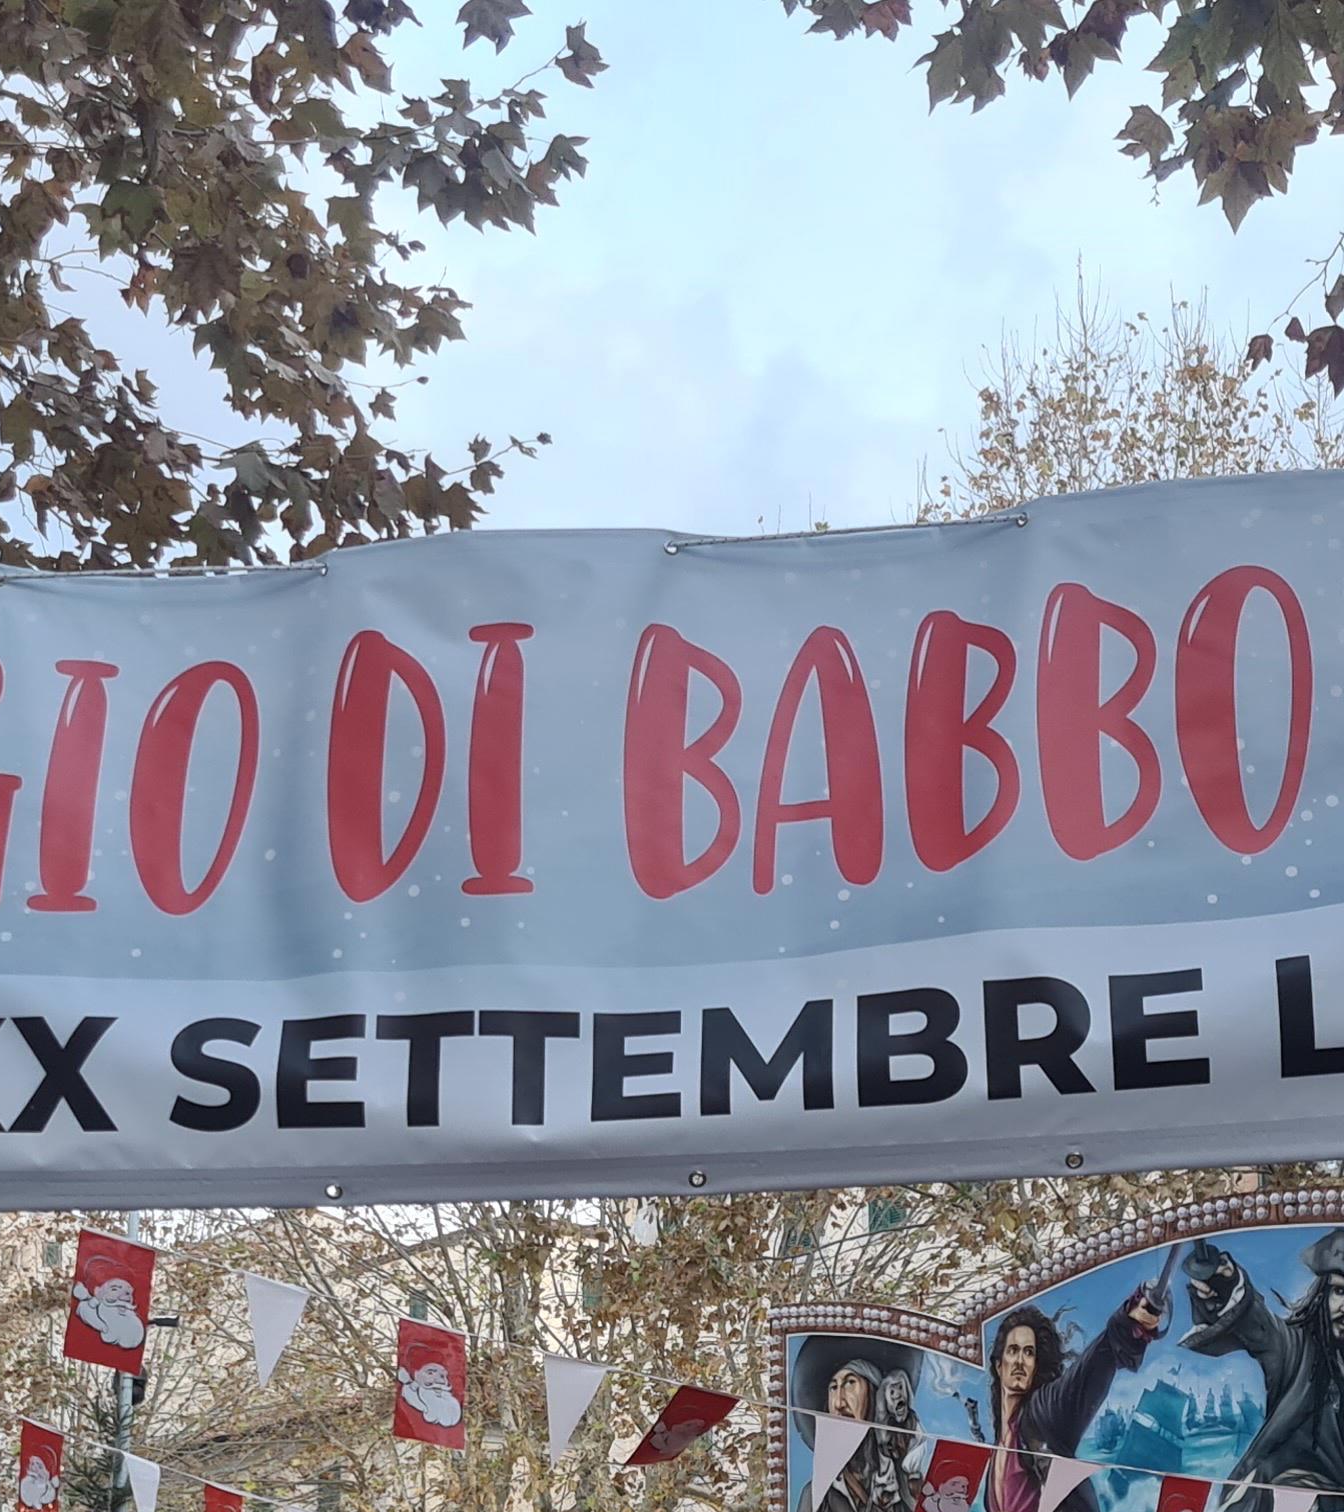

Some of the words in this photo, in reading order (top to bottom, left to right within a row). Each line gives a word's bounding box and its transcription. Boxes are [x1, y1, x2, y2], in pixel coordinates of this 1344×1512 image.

[327, 622, 535, 904] DI
[623, 565, 1313, 900] BABBO
[168, 967, 1211, 1133] SETTEMBRE
